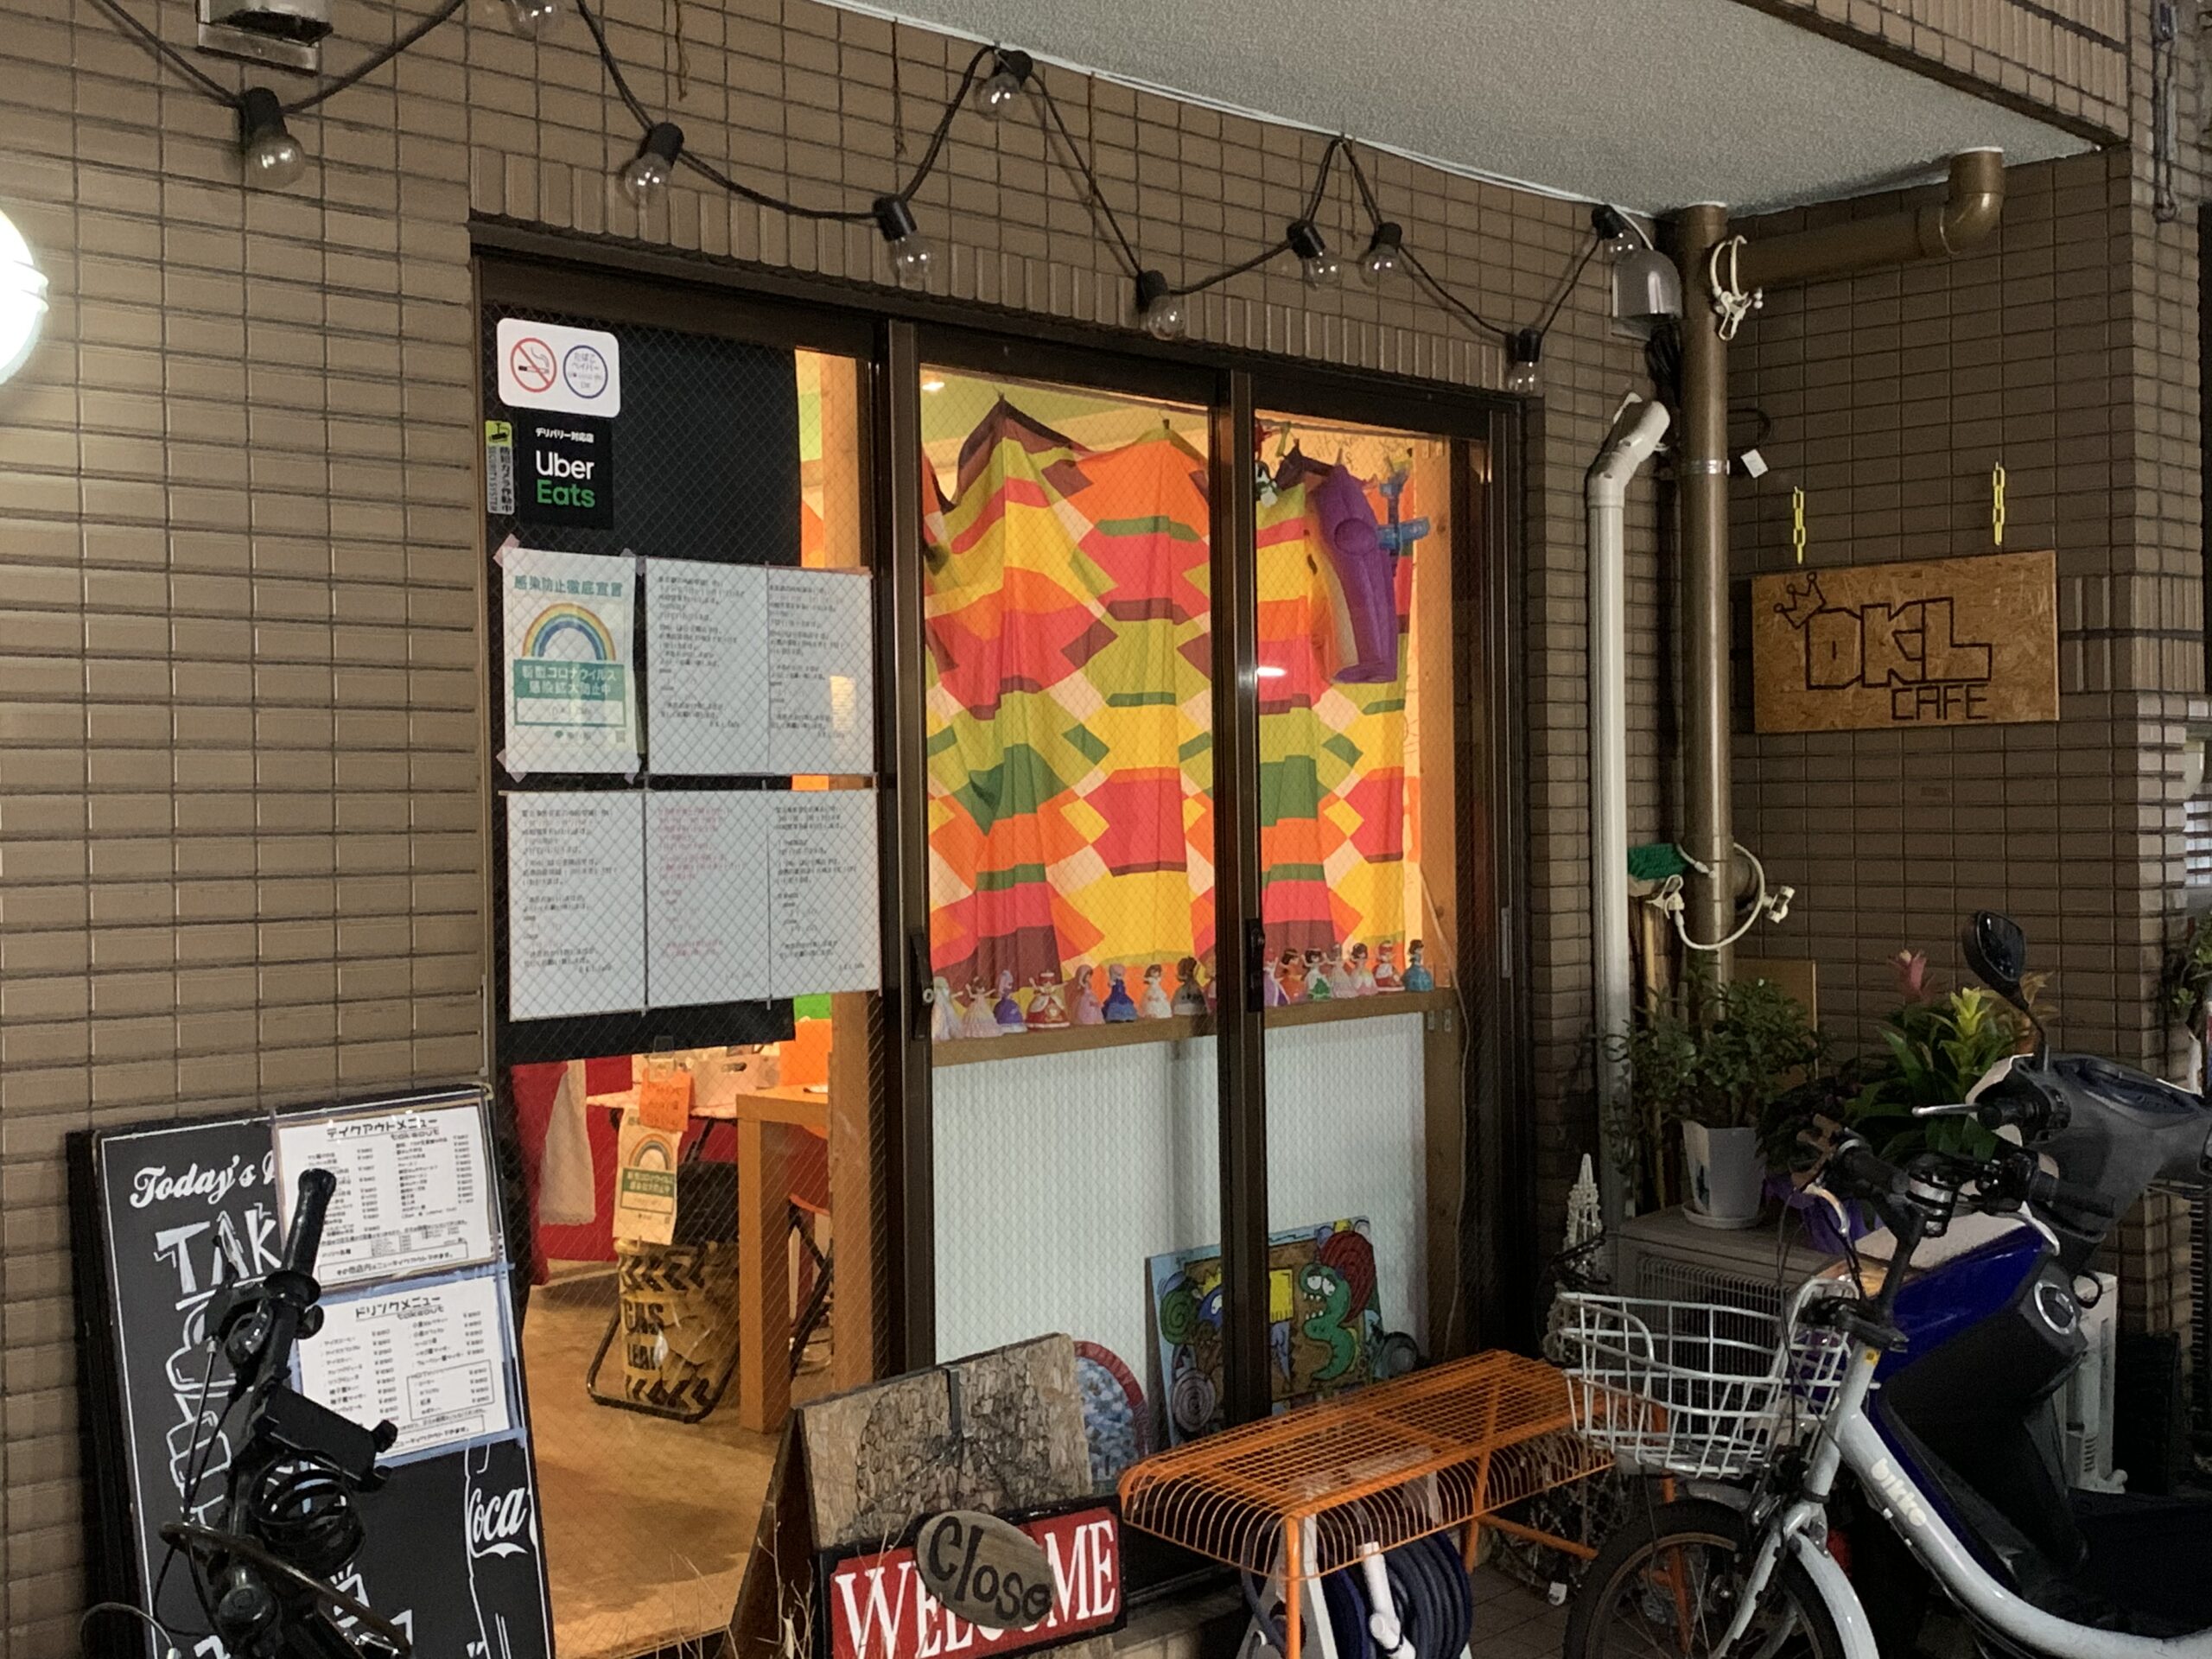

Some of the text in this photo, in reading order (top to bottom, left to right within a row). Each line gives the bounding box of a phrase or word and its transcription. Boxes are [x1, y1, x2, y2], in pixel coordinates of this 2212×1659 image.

[535, 448, 595, 480] Uber
[536, 478, 596, 508] Eats
[1891, 683, 1989, 721] CAFE
[130, 1154, 257, 1209] Today's
[355, 1296, 442, 1319] ドリンクメニュー
[835, 1520, 1116, 1659] WELME
